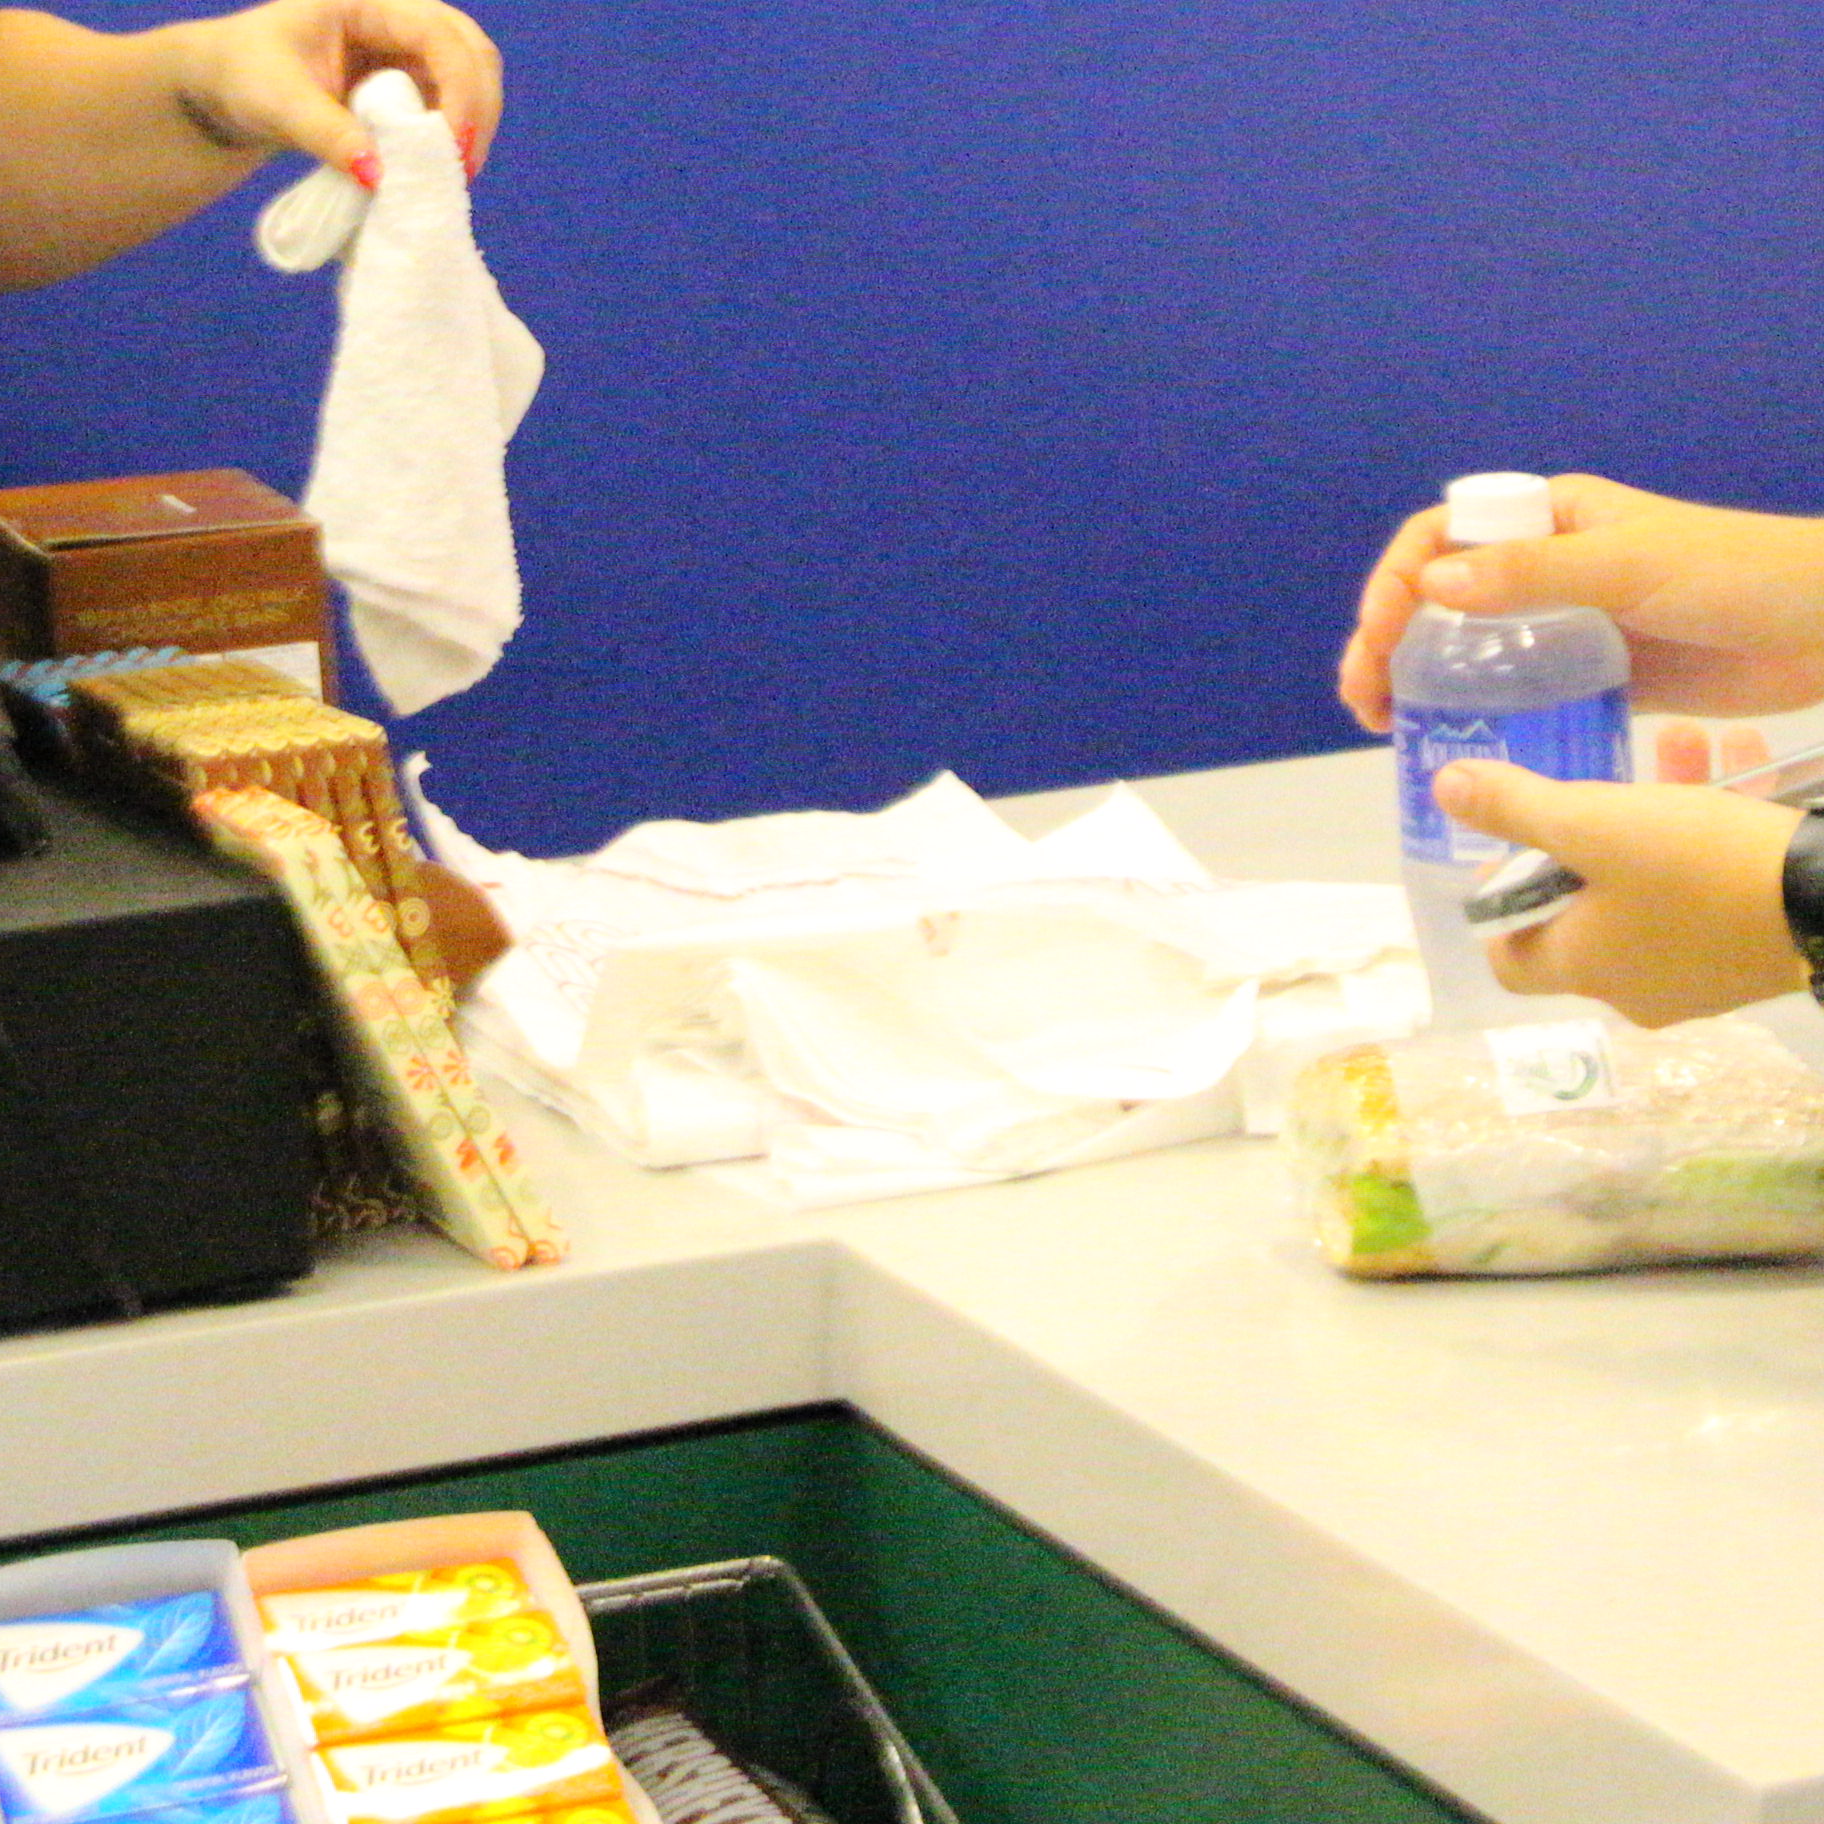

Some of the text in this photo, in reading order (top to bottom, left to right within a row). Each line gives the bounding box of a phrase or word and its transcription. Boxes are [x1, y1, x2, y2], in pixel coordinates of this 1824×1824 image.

[328, 1654, 450, 1692] Trident
[22, 1736, 149, 1777] Trident
[360, 1750, 484, 1788] Trident
